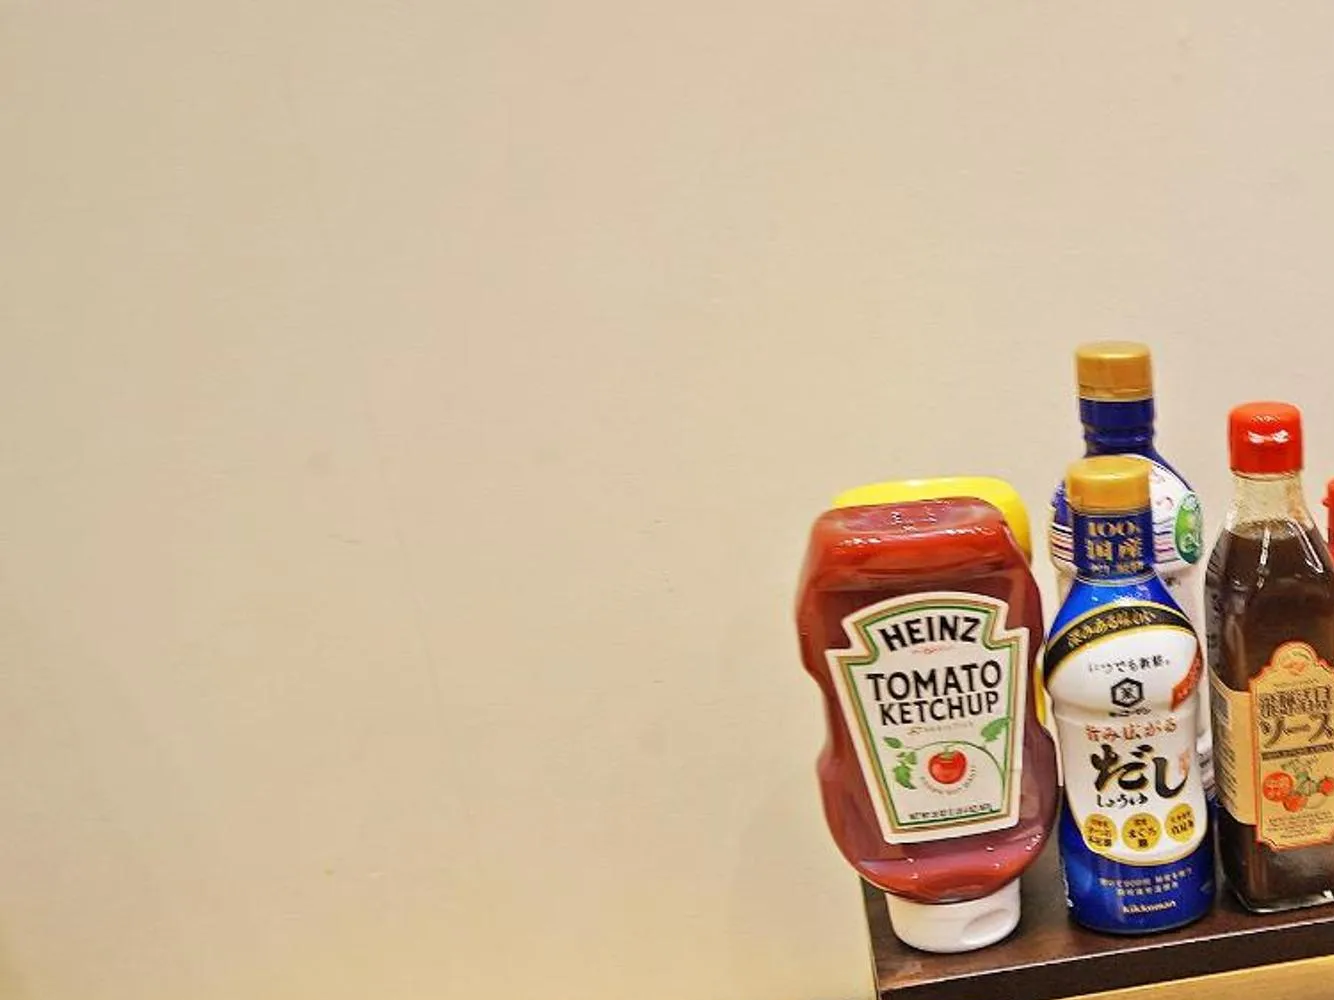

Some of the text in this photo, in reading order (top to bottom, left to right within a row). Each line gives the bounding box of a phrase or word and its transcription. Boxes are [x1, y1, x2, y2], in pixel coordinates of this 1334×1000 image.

[878, 615, 981, 652] HEINZ
[866, 660, 1001, 702] TOMATO
[880, 691, 999, 726] KETCHUP
[1260, 712, 1334, 749] ソース
[1089, 743, 1191, 799] だし
[1096, 793, 1149, 809] しょうゆ
